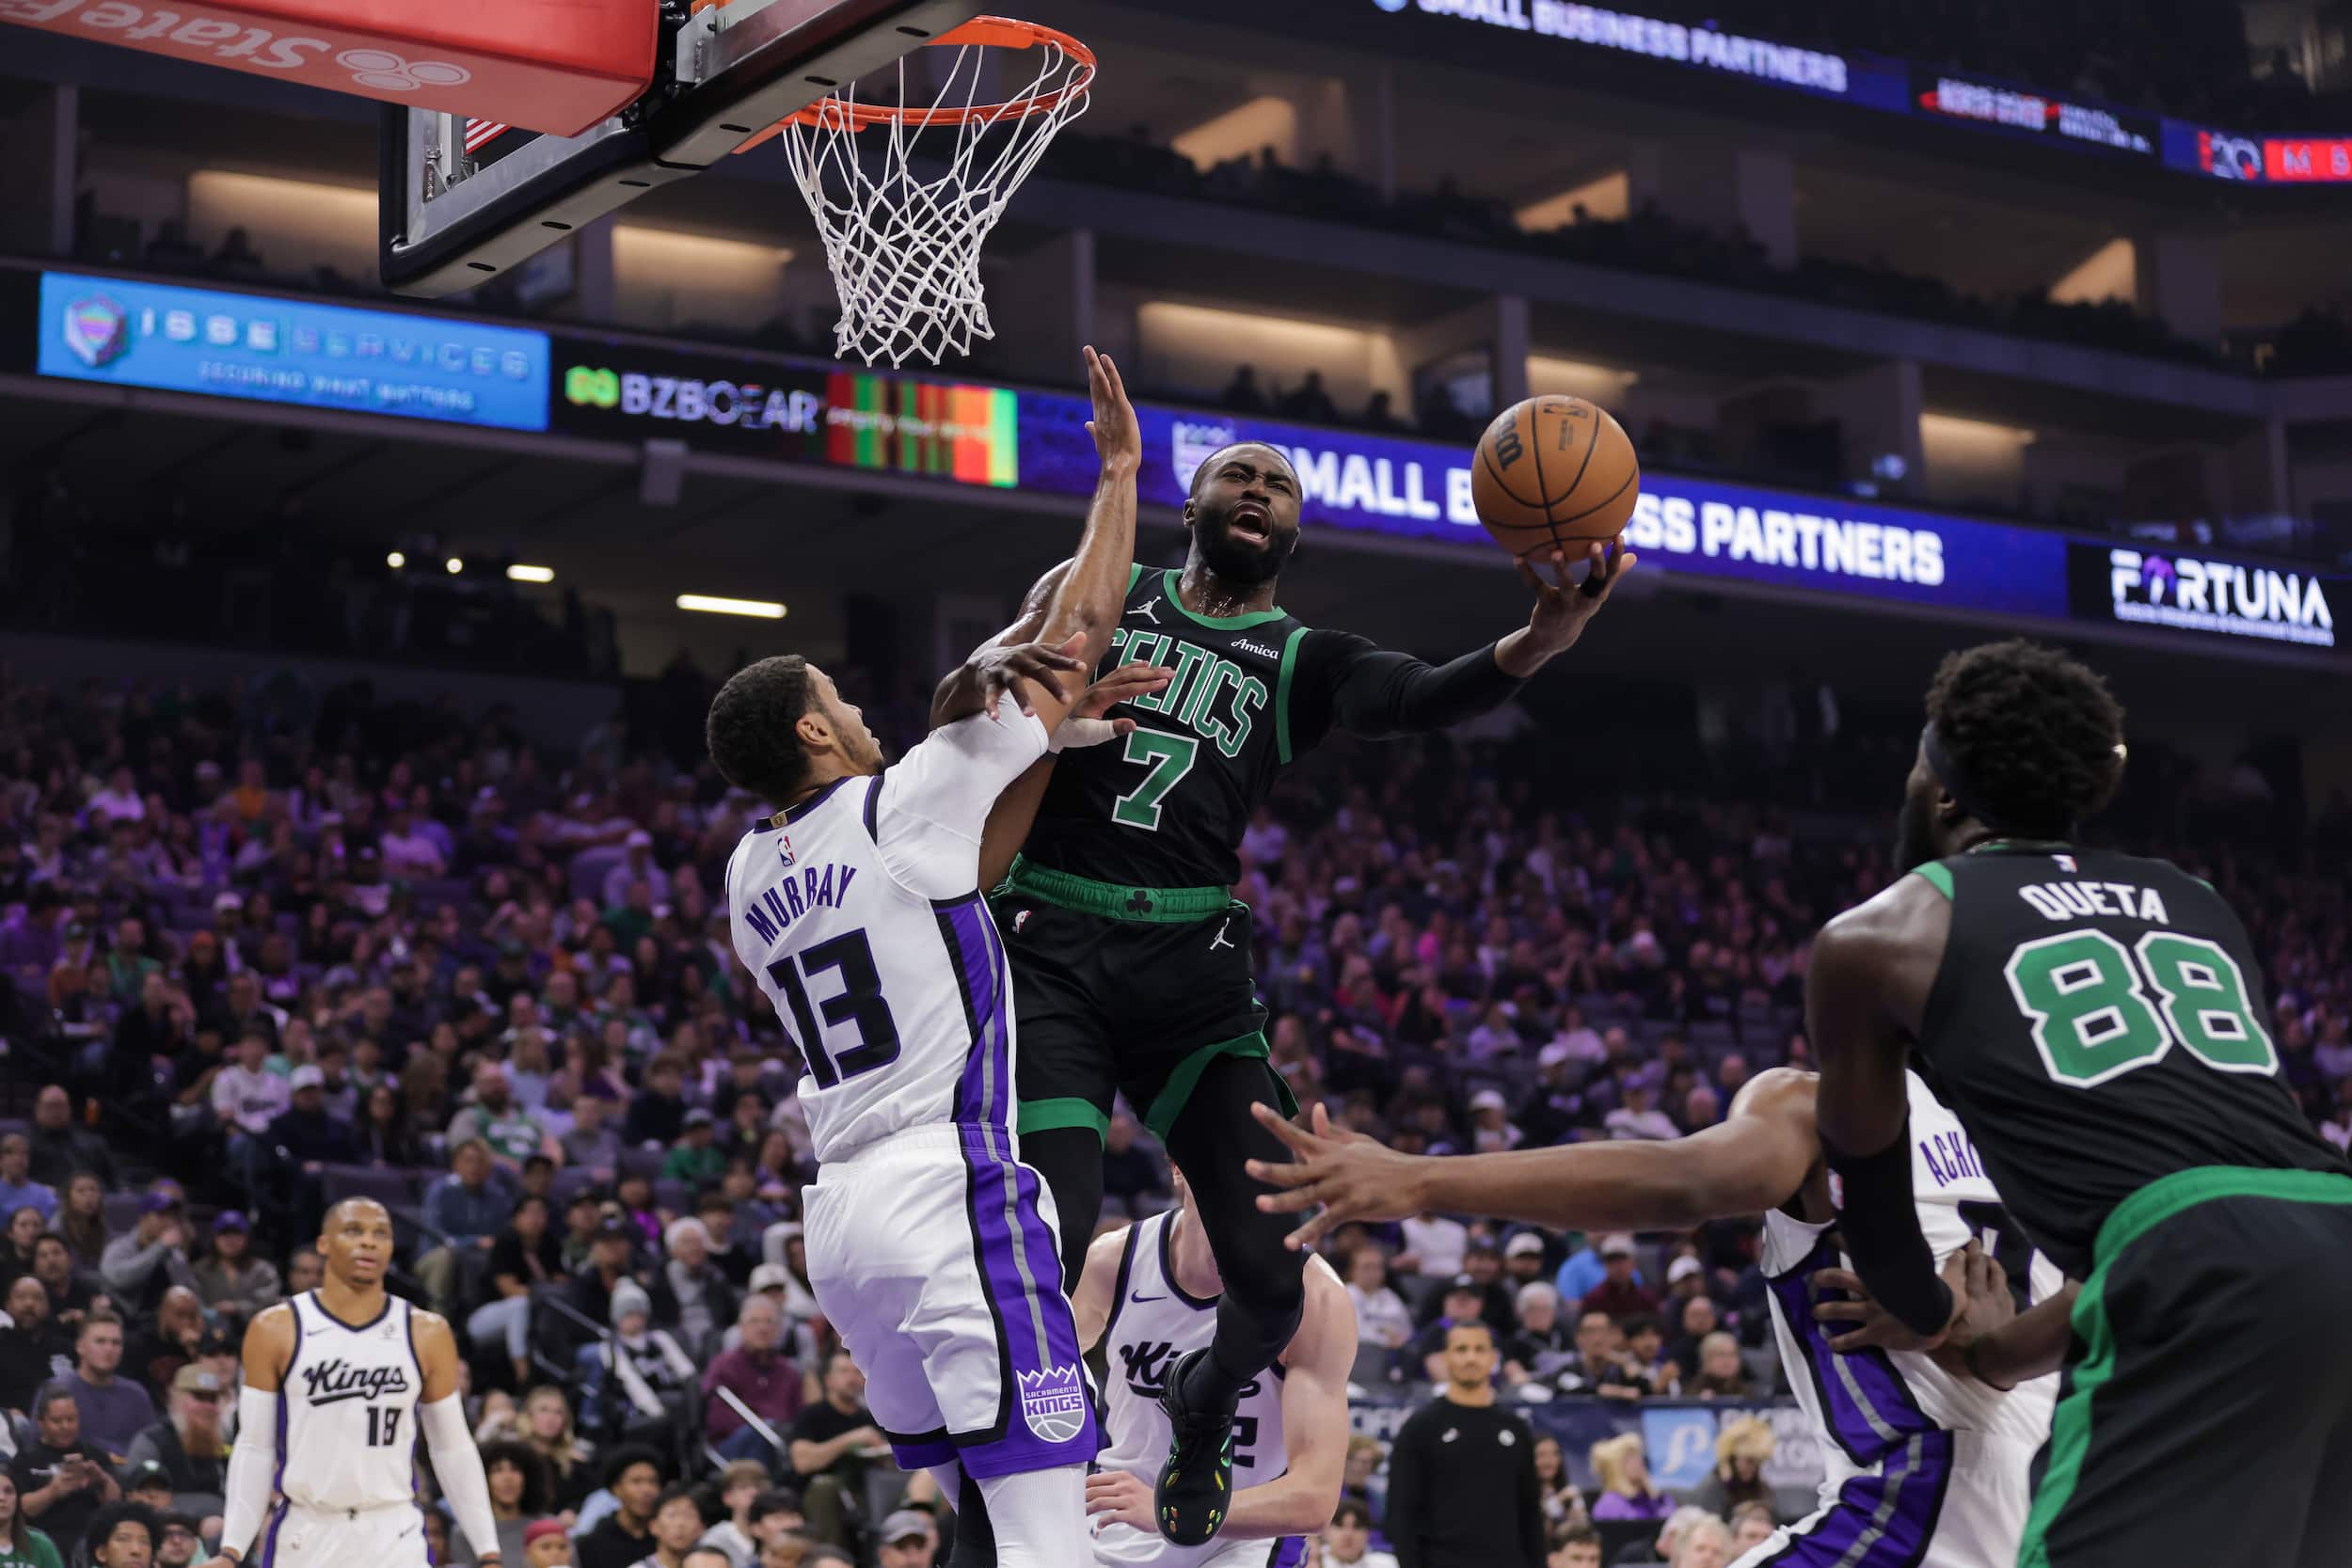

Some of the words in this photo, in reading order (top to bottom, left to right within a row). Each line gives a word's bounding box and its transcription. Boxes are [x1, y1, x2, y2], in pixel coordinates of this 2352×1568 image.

[80, 3, 332, 69] State
[1691, 27, 1848, 92] PARTNERS
[1270, 443, 1440, 521] MALL
[1701, 500, 1945, 586] PARTNERS
[1231, 639, 1279, 659] Amica
[1112, 725, 1200, 832] 7
[745, 863, 857, 946] MURRAY
[2019, 881, 2169, 924] QUETA
[767, 927, 901, 1090] 13
[2004, 928, 2280, 1088] 88
[302, 1358, 408, 1407] Kings
[1025, 1386, 1078, 1400] SACRAMENTO
[1025, 1395, 1084, 1417] KINGS
[366, 1406, 403, 1447] 18
